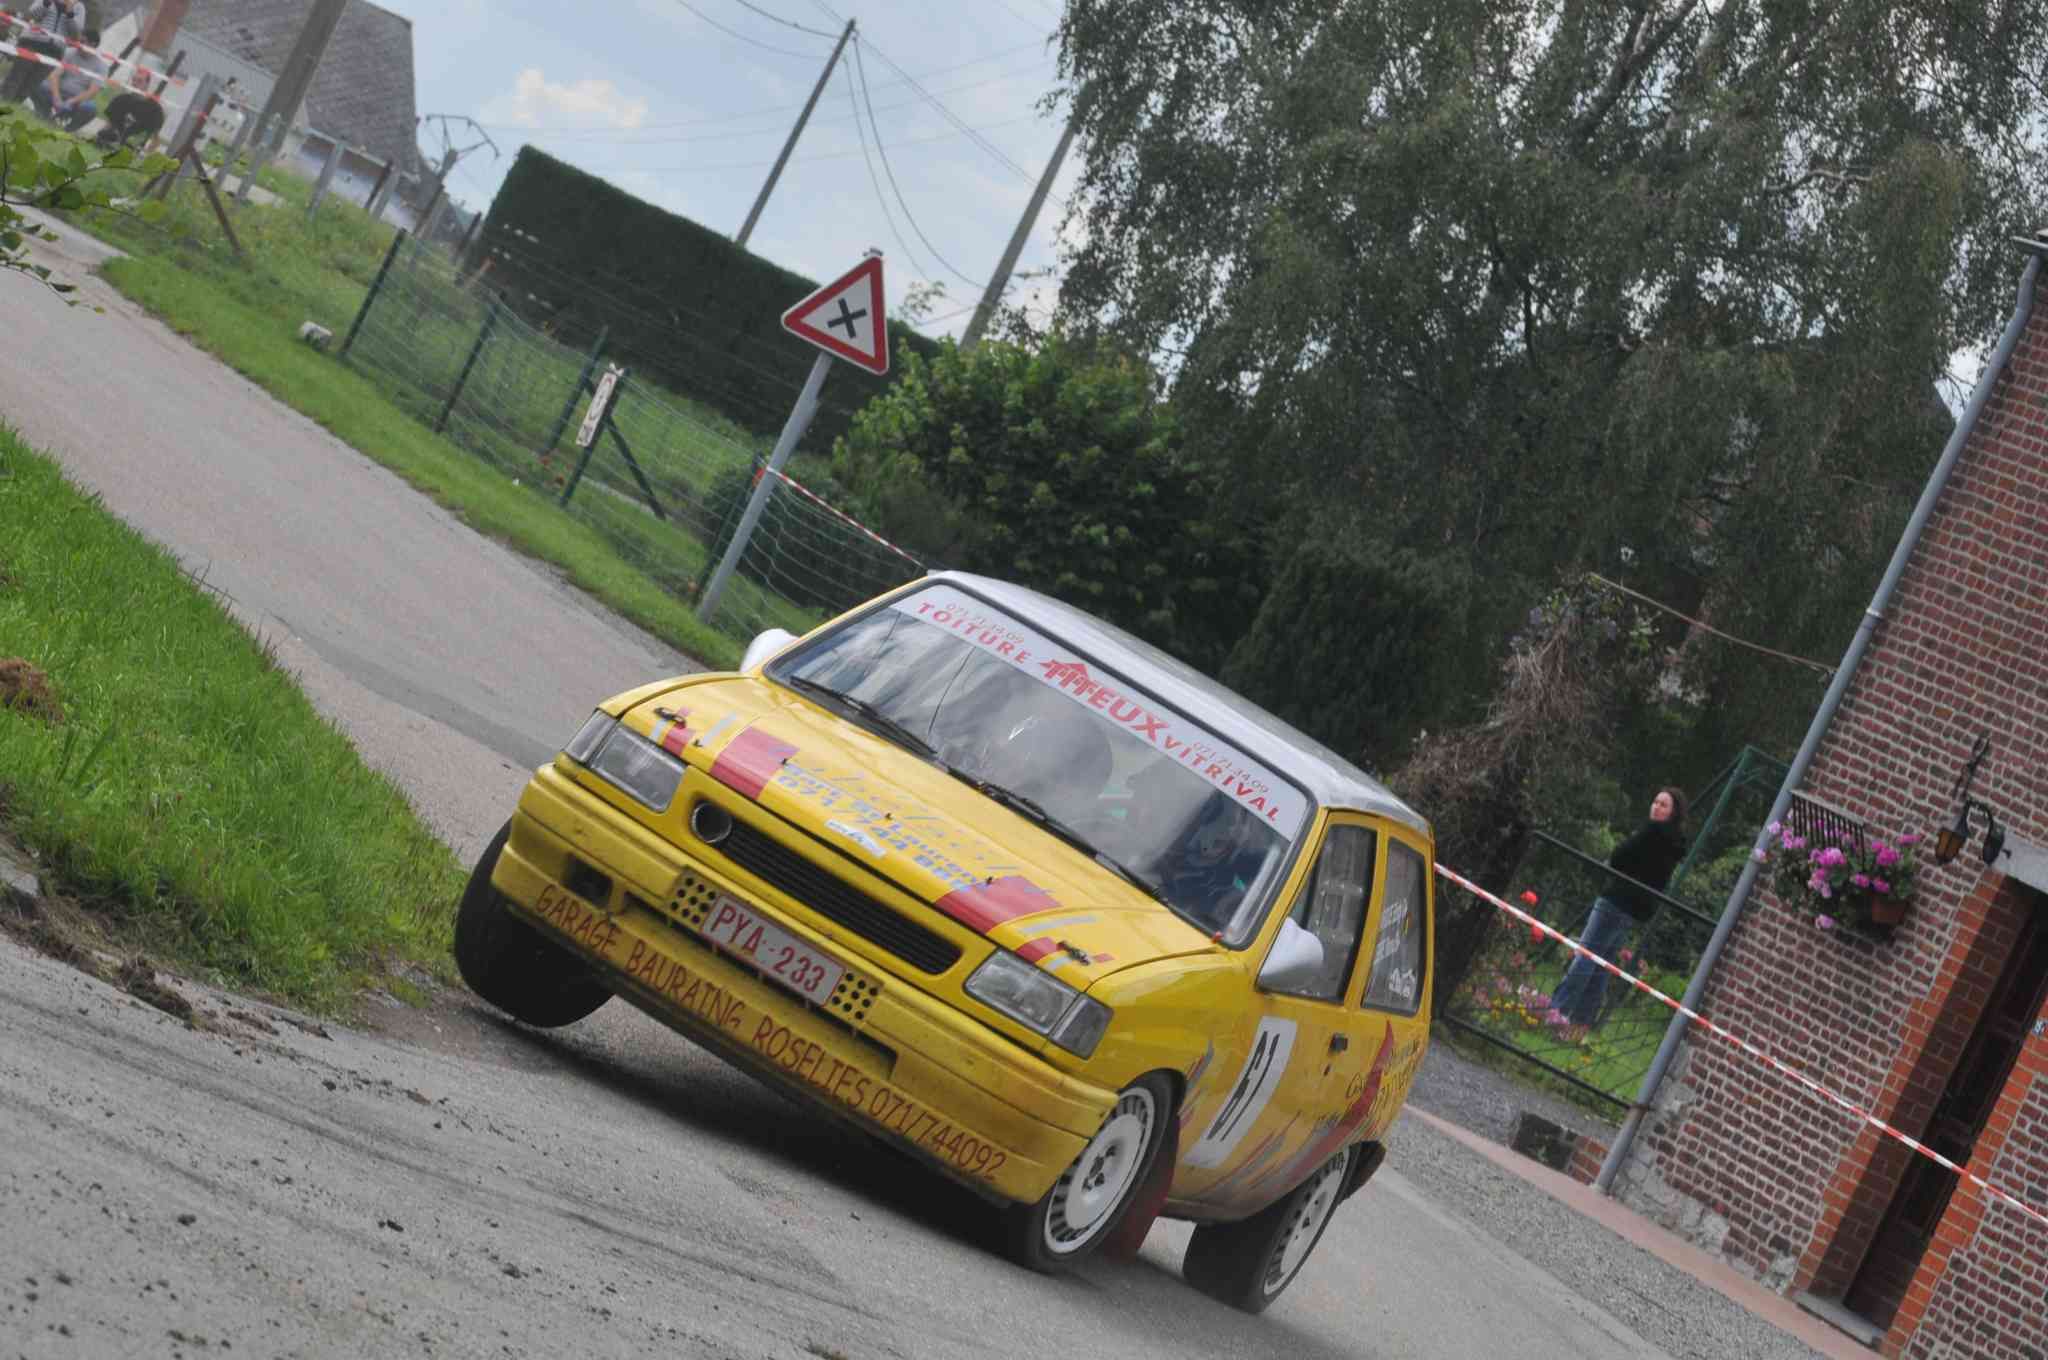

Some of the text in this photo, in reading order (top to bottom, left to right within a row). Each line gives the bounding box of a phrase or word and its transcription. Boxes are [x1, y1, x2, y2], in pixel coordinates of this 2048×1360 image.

[918, 602, 1032, 664] TOITURE
[1165, 735, 1278, 822] VITRIVAL
[536, 884, 623, 950] GARAGE
[868, 1088, 1008, 1180] 071/744092
